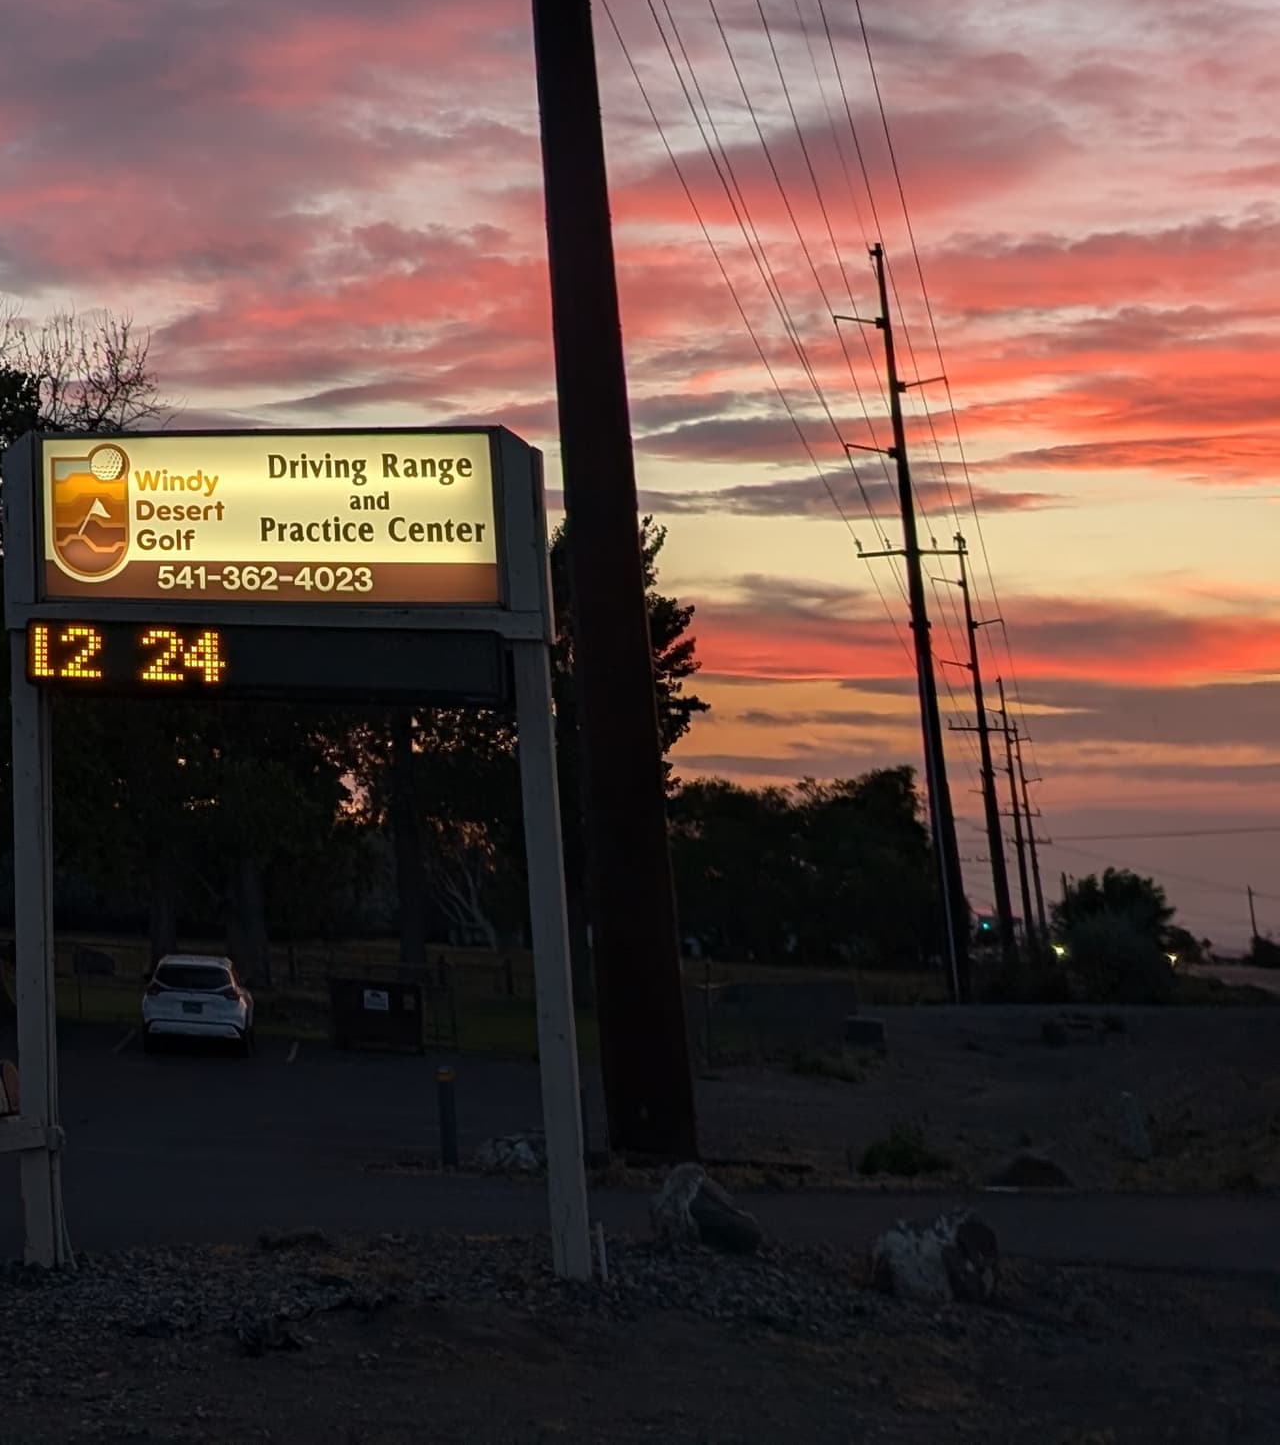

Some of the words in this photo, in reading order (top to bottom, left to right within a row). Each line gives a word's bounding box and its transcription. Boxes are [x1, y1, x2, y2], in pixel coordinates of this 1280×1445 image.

[134, 469, 219, 497] Windy
[268, 453, 368, 486] Driving
[382, 453, 473, 486] Range
[136, 500, 225, 521] Desert
[349, 491, 391, 511] and
[136, 529, 196, 551] Golf
[260, 516, 375, 543] Practice
[388, 517, 486, 543] Center
[157, 565, 374, 593] 541-362-4023
[142, 631, 226, 682] 24
